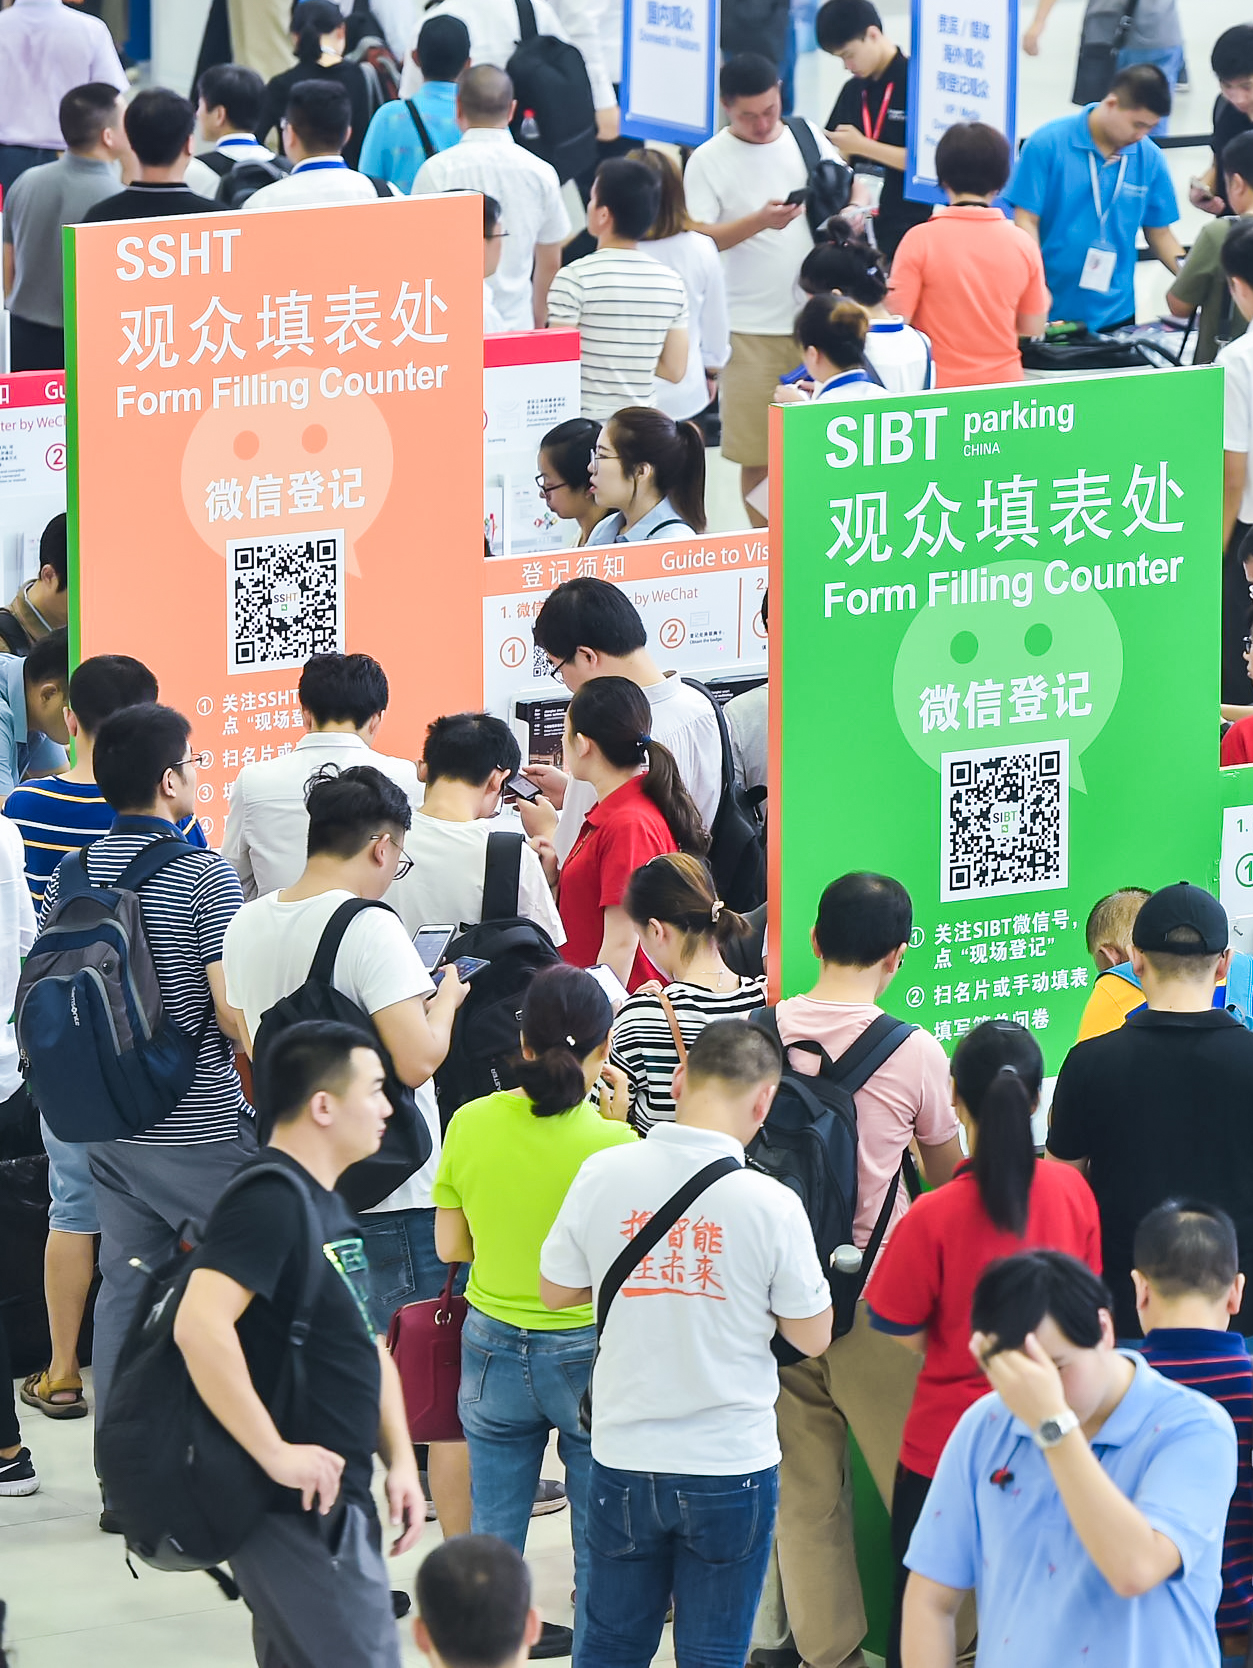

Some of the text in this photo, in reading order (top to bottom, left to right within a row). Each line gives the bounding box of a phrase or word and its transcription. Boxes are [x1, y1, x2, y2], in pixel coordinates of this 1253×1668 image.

[115, 228, 241, 281] SSHT
[116, 279, 449, 372] 观众填表处
[116, 361, 448, 418] Form Filling Counter
[20, 418, 34, 432] by
[36, 414, 66, 428] WeC
[825, 406, 948, 469] SIBT
[963, 399, 1075, 442] parking
[963, 441, 1000, 457] CHINA
[204, 467, 366, 523] 微信登记
[825, 460, 1185, 567] 观众填表处
[522, 554, 626, 589] 登记须知
[661, 547, 715, 571] Guide
[721, 546, 740, 565] to
[824, 551, 1184, 618] Form Filling Counter
[273, 592, 298, 604] SSHT
[634, 591, 649, 607] by
[652, 587, 699, 602] WeChat
[222, 688, 300, 714] 关注SSHT
[919, 671, 1093, 734] 微信登记
[992, 811, 1017, 824] SIBT
[1236, 818, 1249, 833] 1.
[934, 967, 1088, 1005] 扫名片或手动填表
